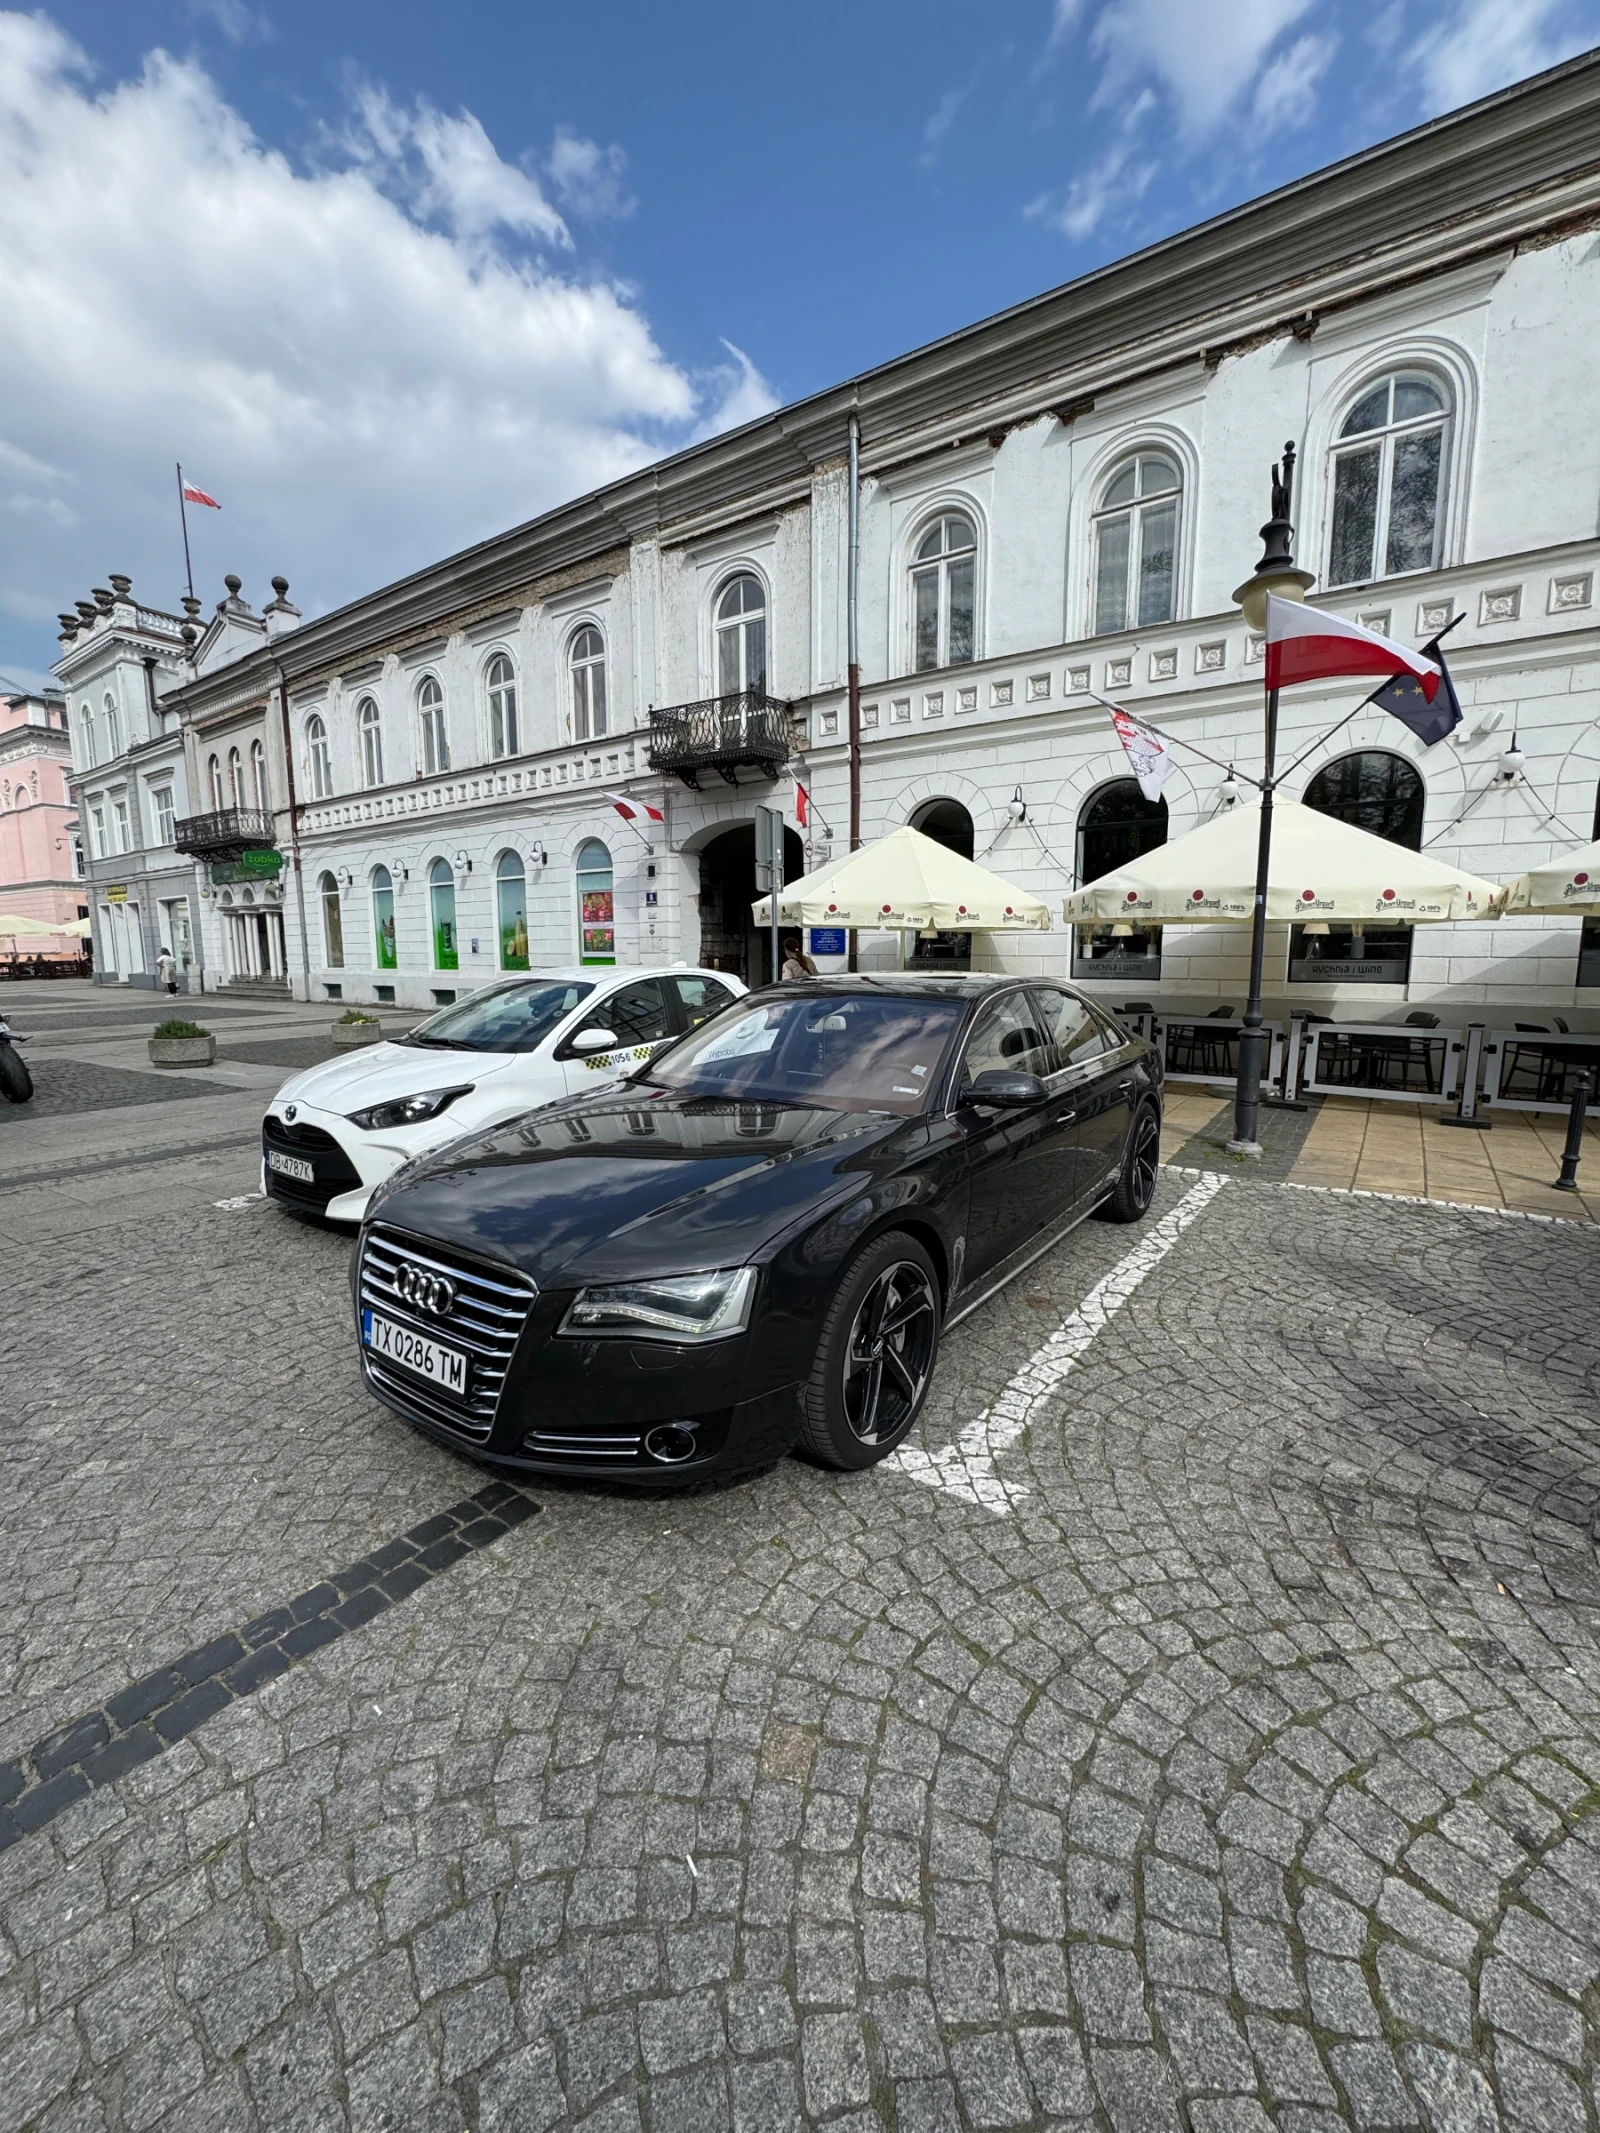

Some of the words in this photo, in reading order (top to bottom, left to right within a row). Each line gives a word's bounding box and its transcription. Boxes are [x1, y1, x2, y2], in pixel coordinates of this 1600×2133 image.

[611, 1053, 631, 1064] 1056
[271, 1152, 281, 1170] DB
[283, 1157, 311, 1180] 4787K
[373, 1317, 393, 1353] TX
[394, 1329, 435, 1374] 0286
[438, 1349, 463, 1388] TM
